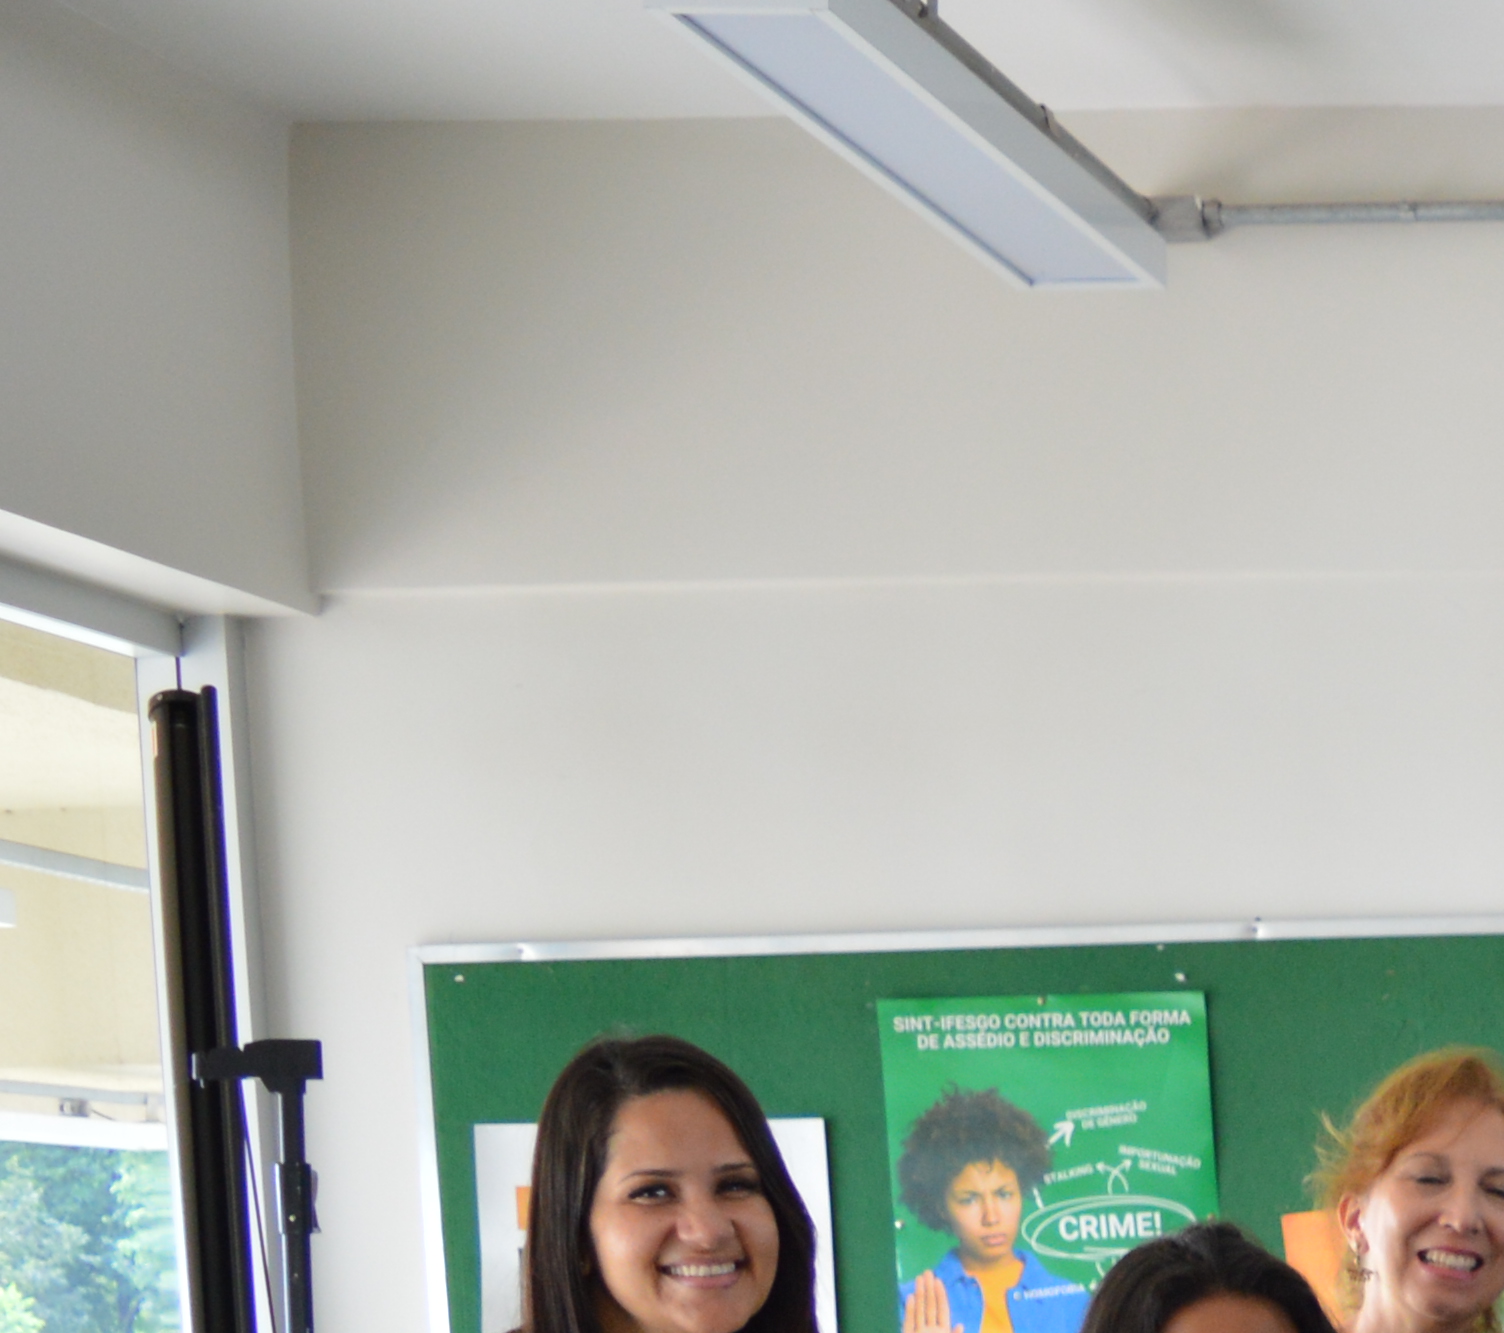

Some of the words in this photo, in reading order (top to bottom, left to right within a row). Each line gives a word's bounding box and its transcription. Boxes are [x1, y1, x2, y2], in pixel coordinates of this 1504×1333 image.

[893, 1014, 1000, 1032] SINT-IFESGO
[1004, 1011, 1075, 1030] CONTRA
[1079, 1010, 1125, 1028] TODA
[1130, 1009, 1191, 1027] FORMA
[917, 1033, 939, 1049] DE
[943, 1030, 1015, 1049] ASSÉDIO
[1019, 1031, 1029, 1047] E
[1034, 1026, 1170, 1047] DISCRIMINAÇÃO
[1058, 1211, 1163, 1242] CRIME!
